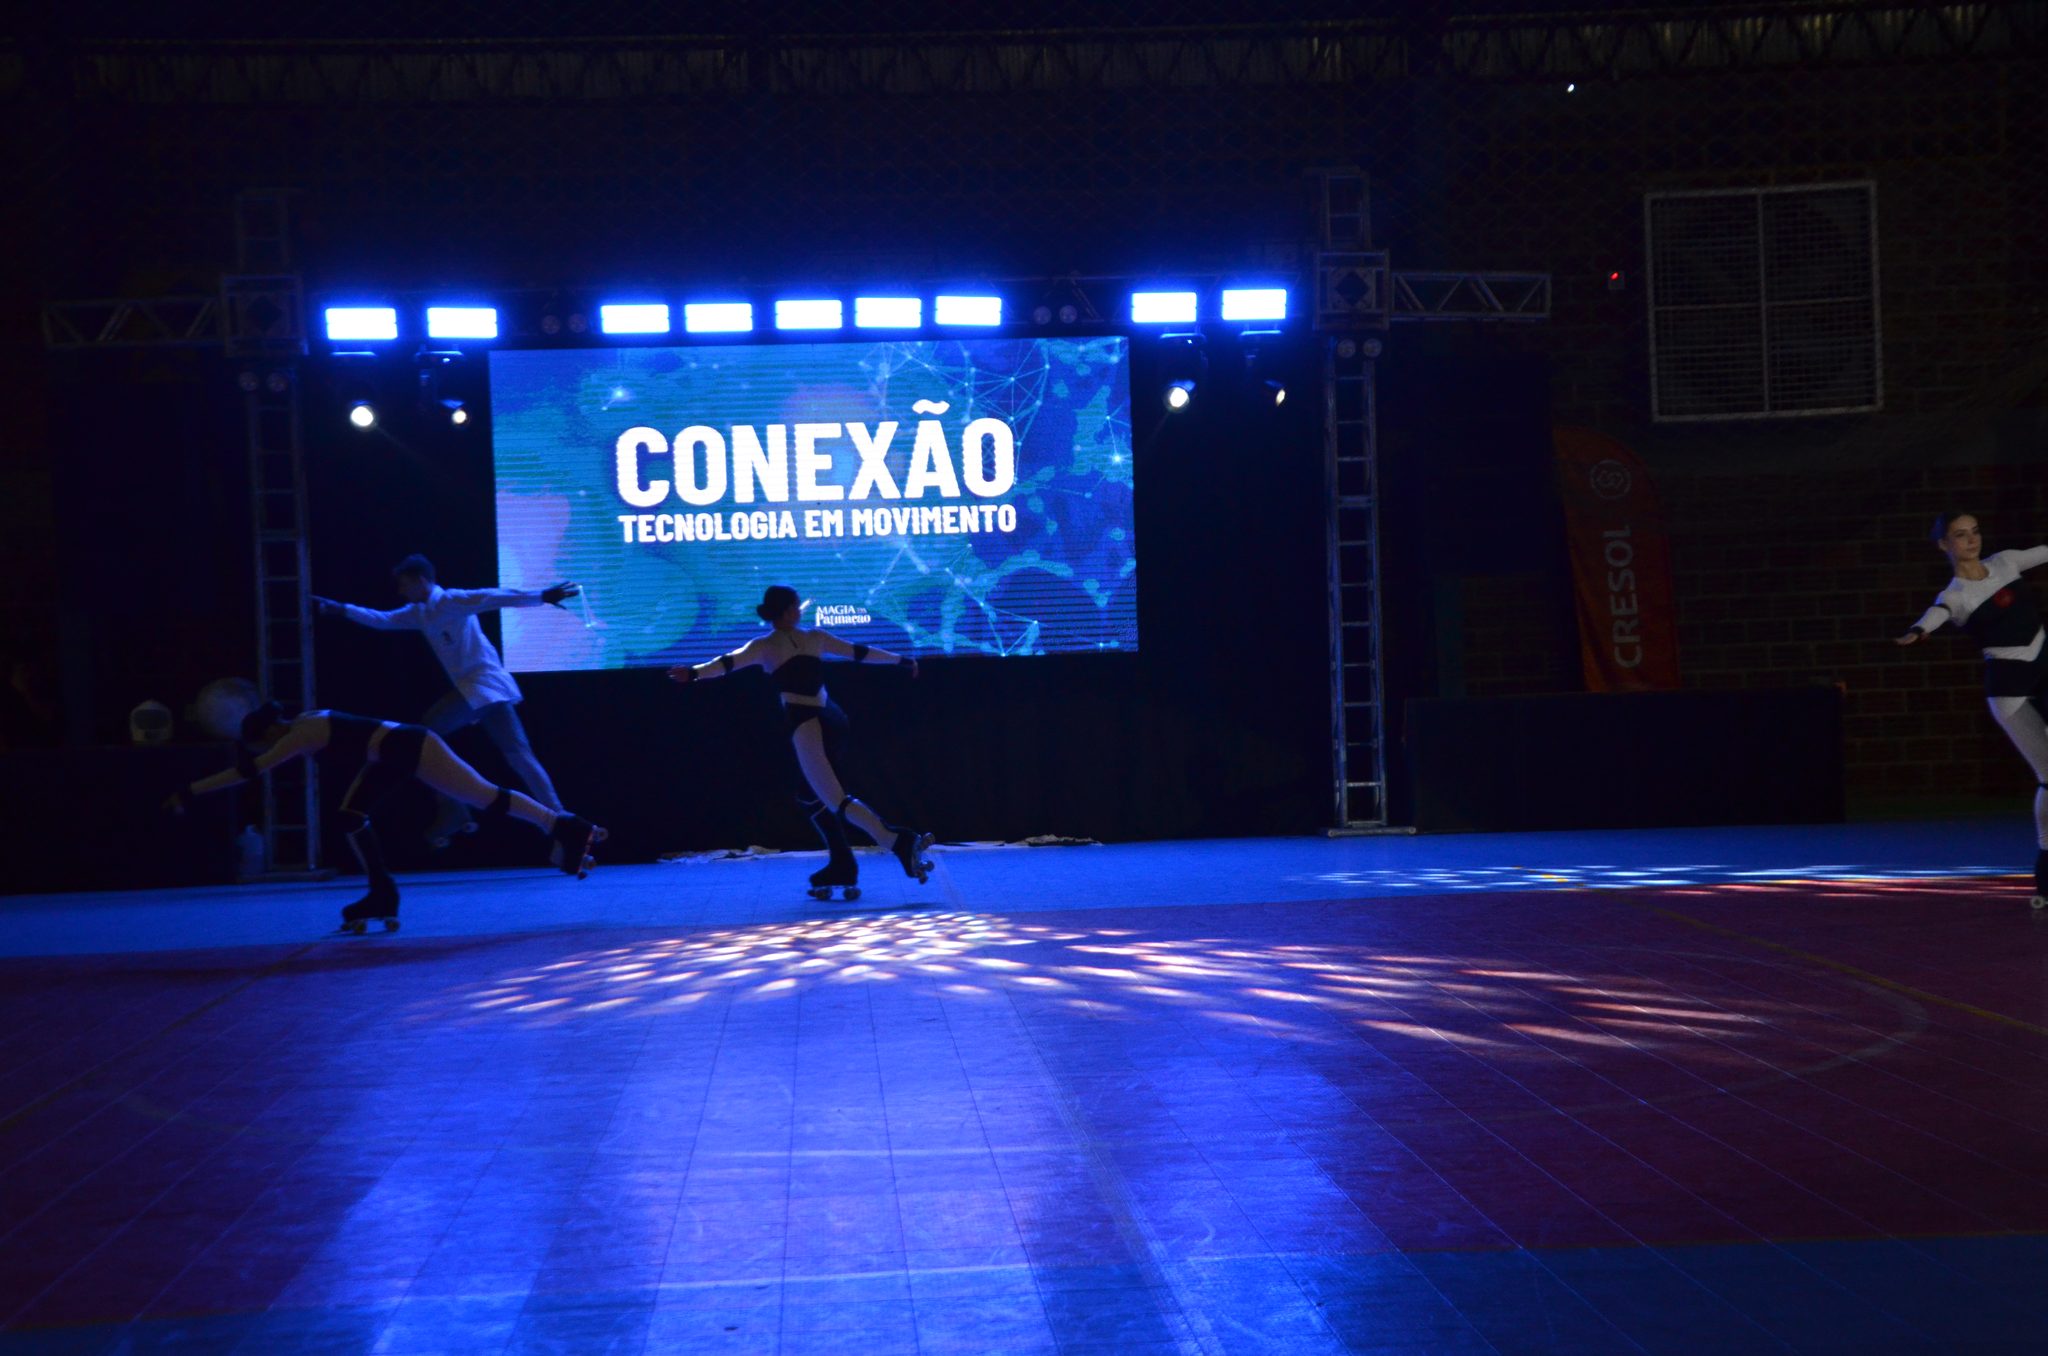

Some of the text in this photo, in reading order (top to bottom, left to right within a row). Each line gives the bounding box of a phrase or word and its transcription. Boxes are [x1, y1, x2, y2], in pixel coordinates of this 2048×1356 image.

[615, 399, 1016, 508] CONEXÃO
[618, 504, 1016, 543] TECNOLOGIA EM MOVIMENTO
[816, 604, 856, 615] MAGIA
[1602, 524, 1643, 668] CRESOL
